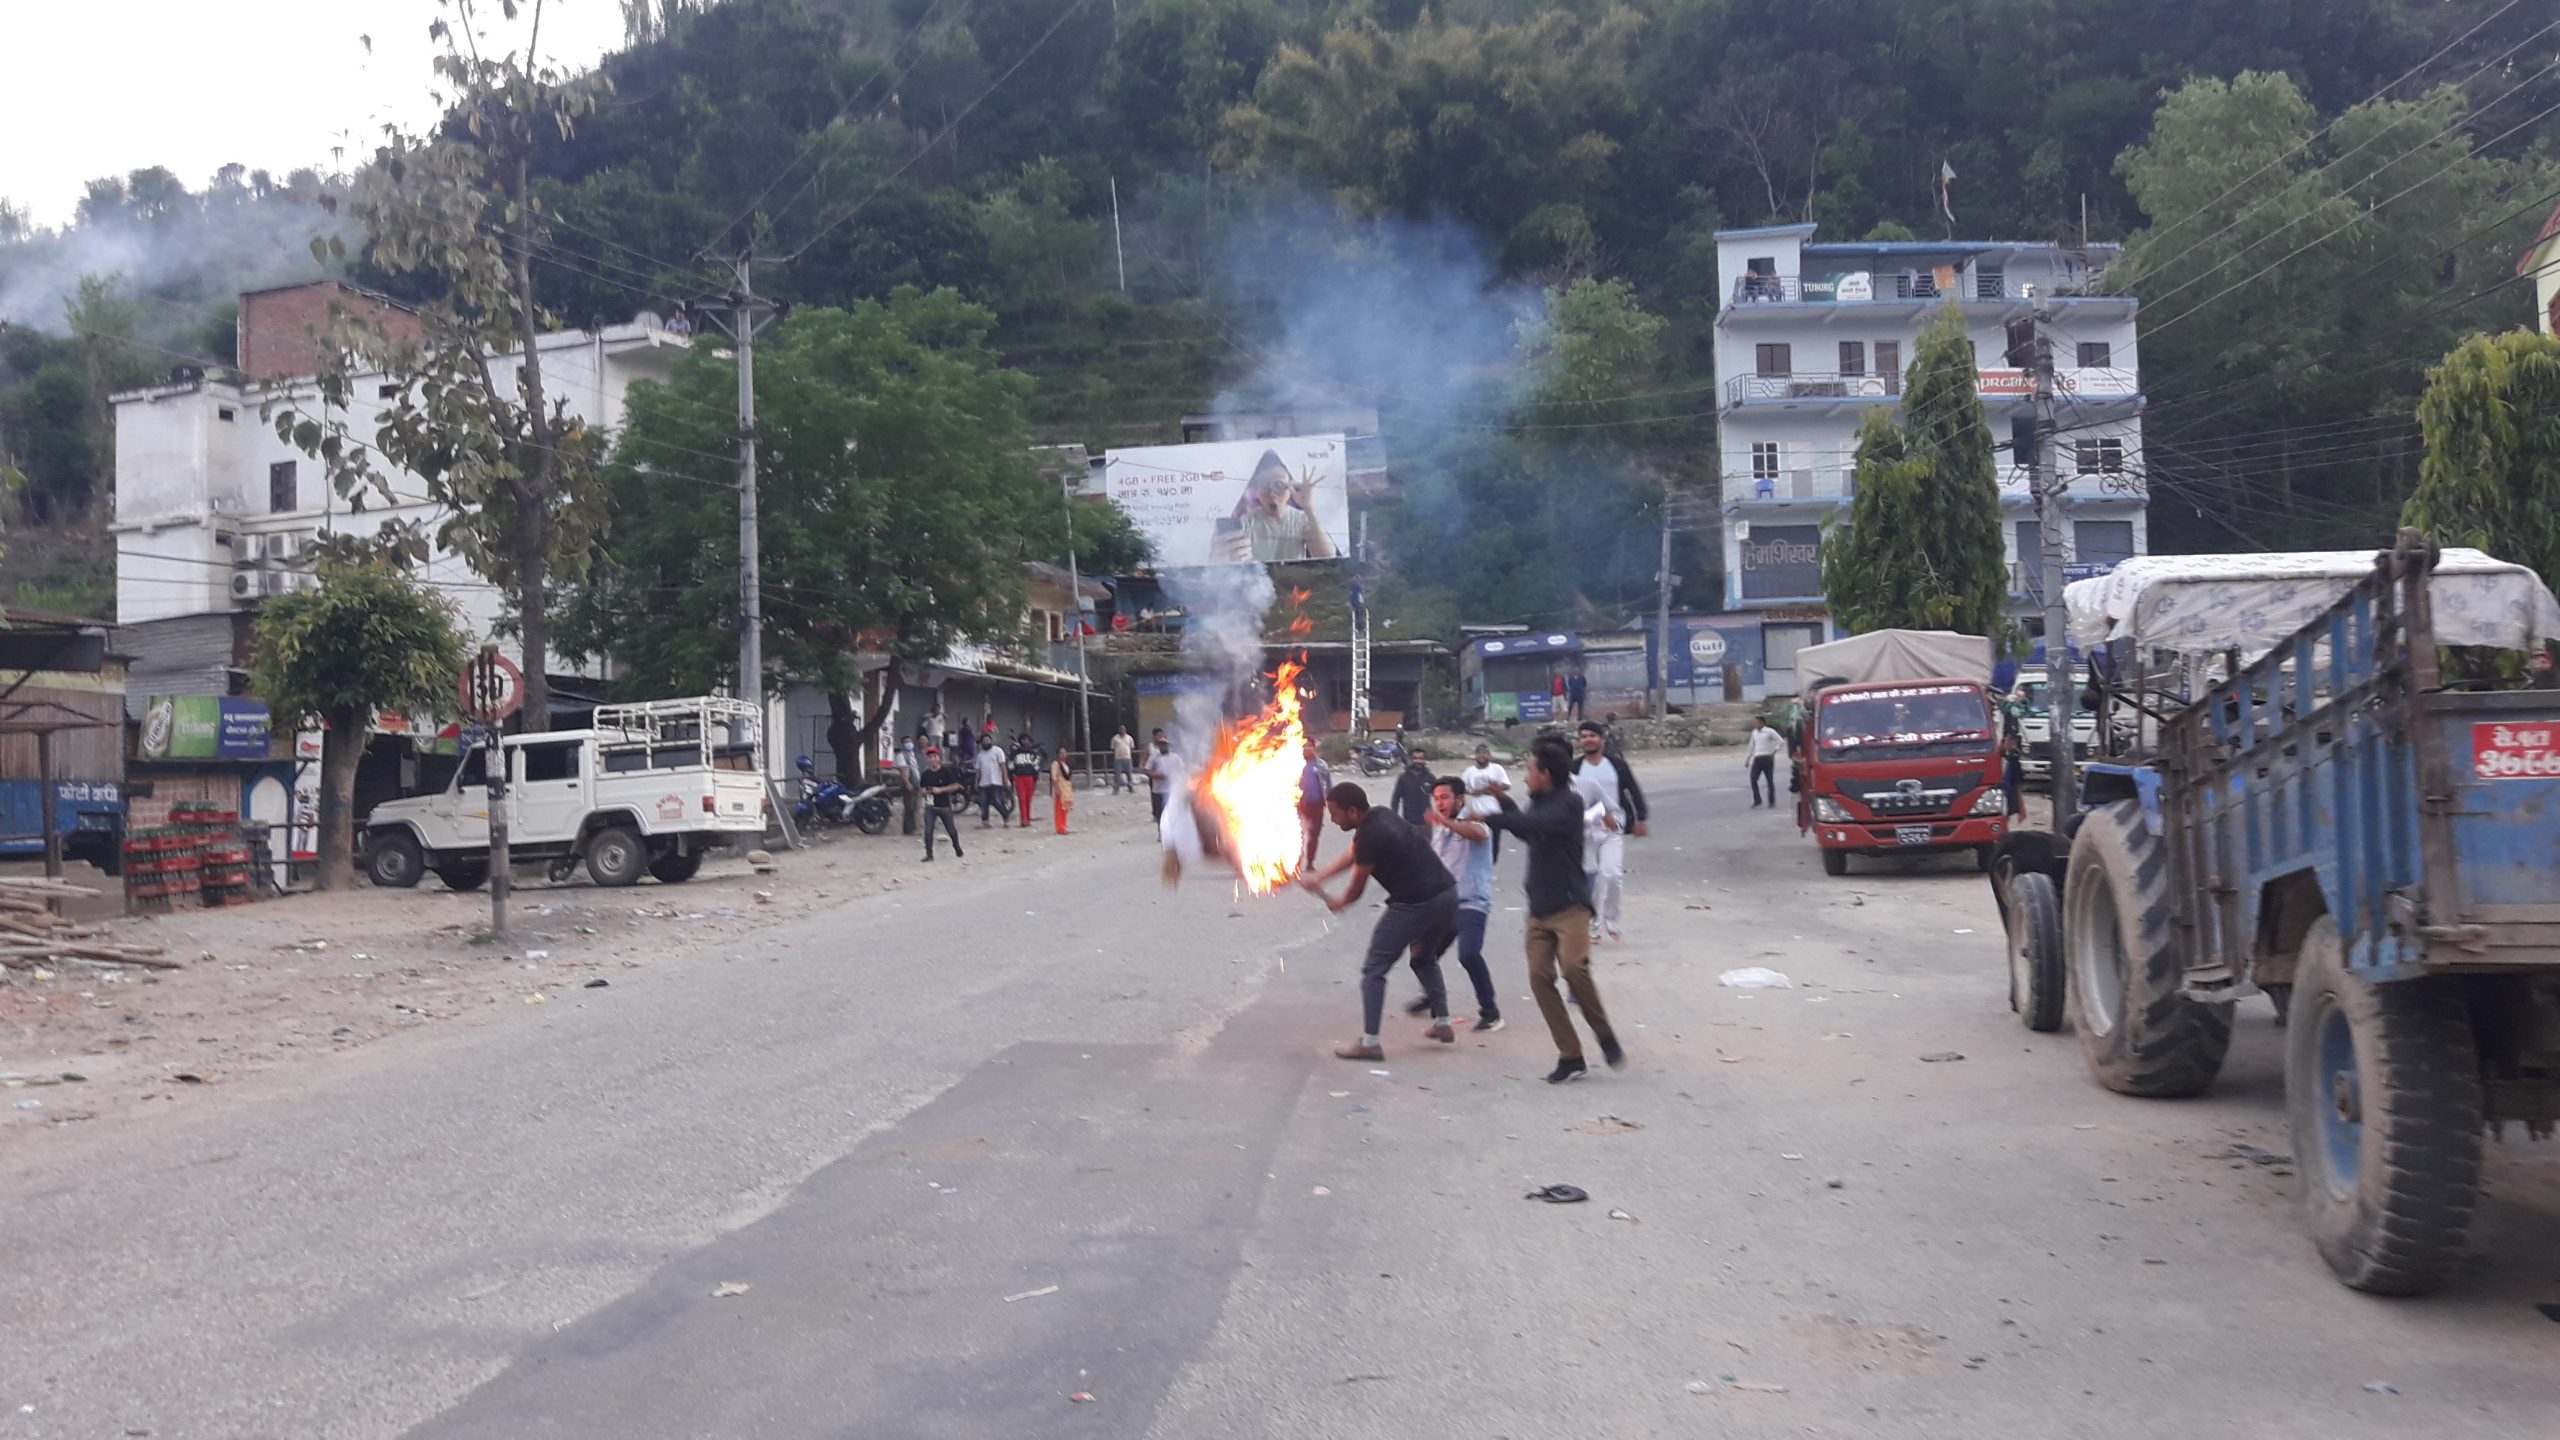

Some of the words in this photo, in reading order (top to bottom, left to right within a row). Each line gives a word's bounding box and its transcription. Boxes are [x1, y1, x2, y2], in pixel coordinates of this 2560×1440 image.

[1803, 282, 1834, 292] TUBORG
[1118, 475, 1139, 486] 4GB
[1151, 474, 1177, 484] FREE
[1180, 473, 1200, 482] 2GB
[1691, 641, 1723, 652] Gulf
[58, 782, 90, 802] फोटो
